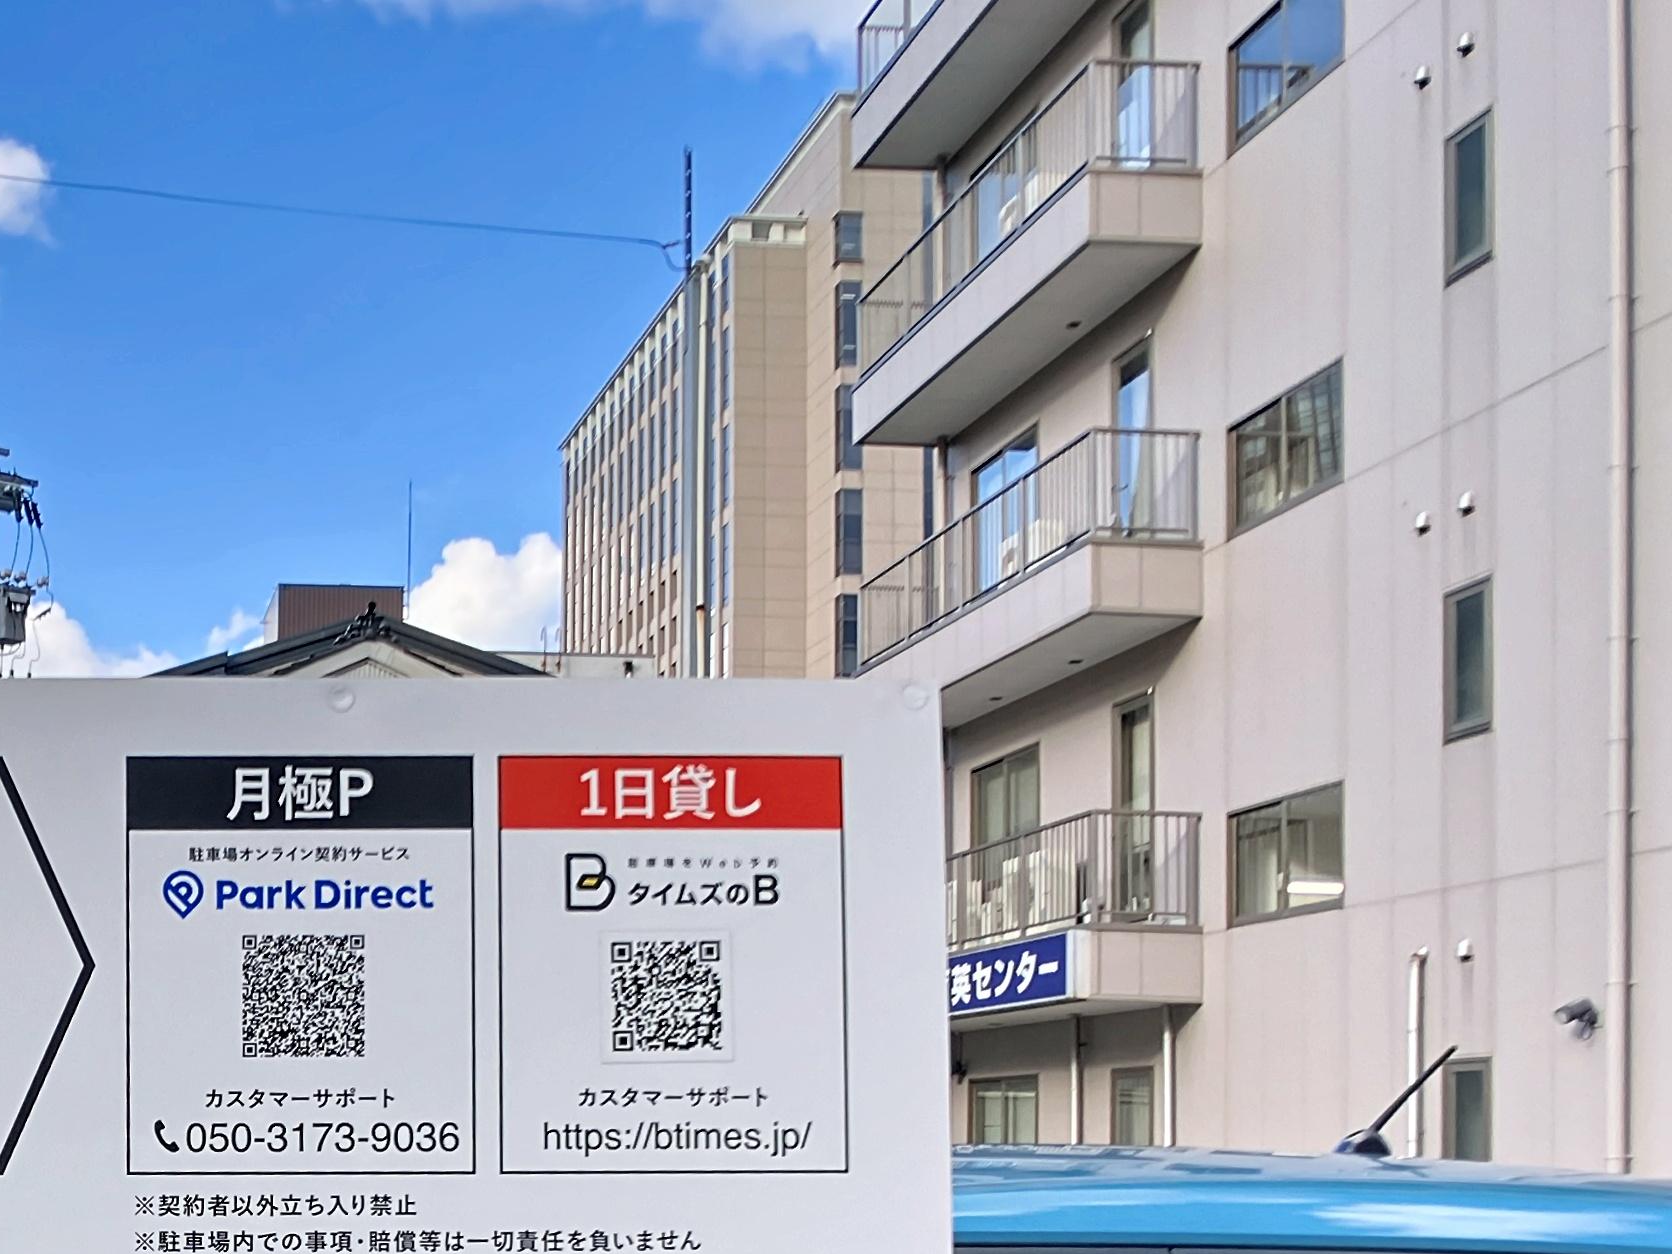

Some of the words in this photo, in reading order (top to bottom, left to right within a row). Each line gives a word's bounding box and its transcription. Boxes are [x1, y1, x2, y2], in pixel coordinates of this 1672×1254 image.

[226, 765, 374, 821] 月極P
[580, 764, 762, 820] 1日貸し
[188, 845, 410, 863] 駐車場オンライン契約サービス
[215, 879, 307, 910] Park
[314, 878, 435, 910] Direct
[627, 873, 780, 906] タイムズのB
[946, 951, 1059, 1007] 英センター
[205, 1087, 395, 1109] カスタマーサポート
[578, 1086, 768, 1108] カスタマーサポート
[186, 1121, 460, 1153] 050-3173-9036
[543, 1121, 813, 1158] https://btimes.jp/
[134, 1193, 417, 1217] ※契約者以外立ち入り禁止
